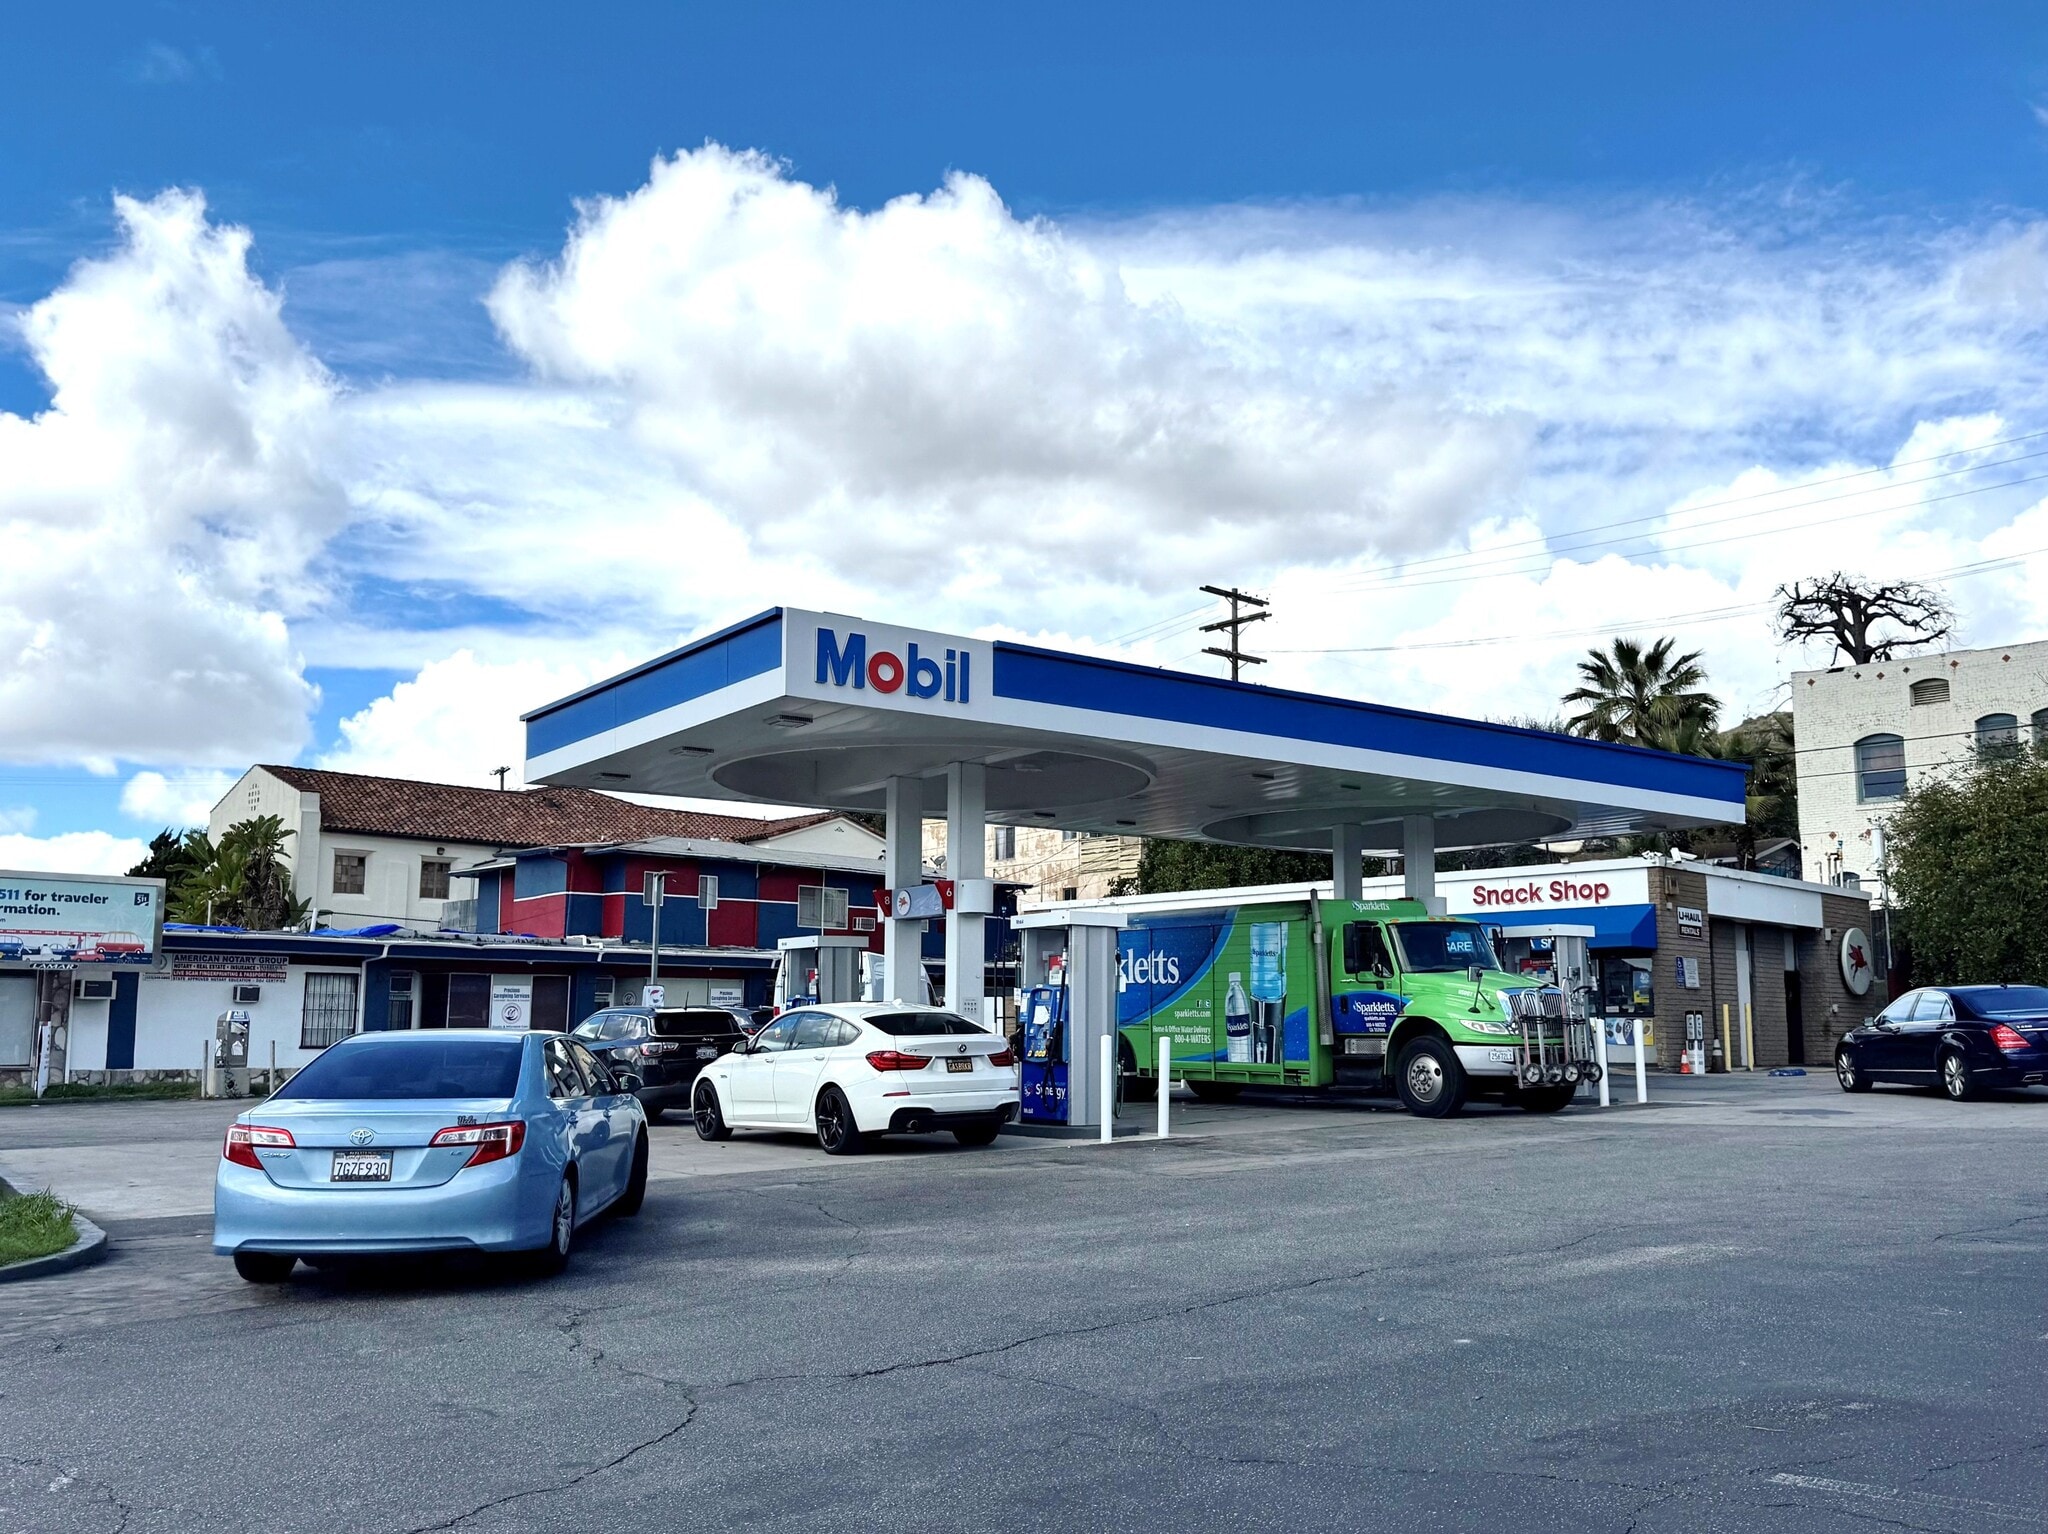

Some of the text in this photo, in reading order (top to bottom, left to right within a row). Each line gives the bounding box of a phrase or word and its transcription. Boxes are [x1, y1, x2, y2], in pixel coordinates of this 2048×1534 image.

[815, 627, 970, 704] Mobil
[24, 889, 47, 901] for
[51, 891, 108, 905] traveler
[946, 888, 952, 897] 6
[1473, 880, 1612, 907] Snack Shop
[884, 896, 891, 905] 8
[1353, 901, 1390, 912] Sparkletts
[1679, 911, 1701, 923] U-HAUL
[1681, 926, 1700, 936] RENTALS
[174, 954, 220, 963] AMERICAN
[222, 955, 257, 964] NOTARY
[1355, 1001, 1397, 1015] Sparkletts
[1174, 1009, 1211, 1019] sparkletts.com
[1174, 1034, 1211, 1044] 800-4-WATERS
[1035, 1083, 1066, 1100] Synegy
